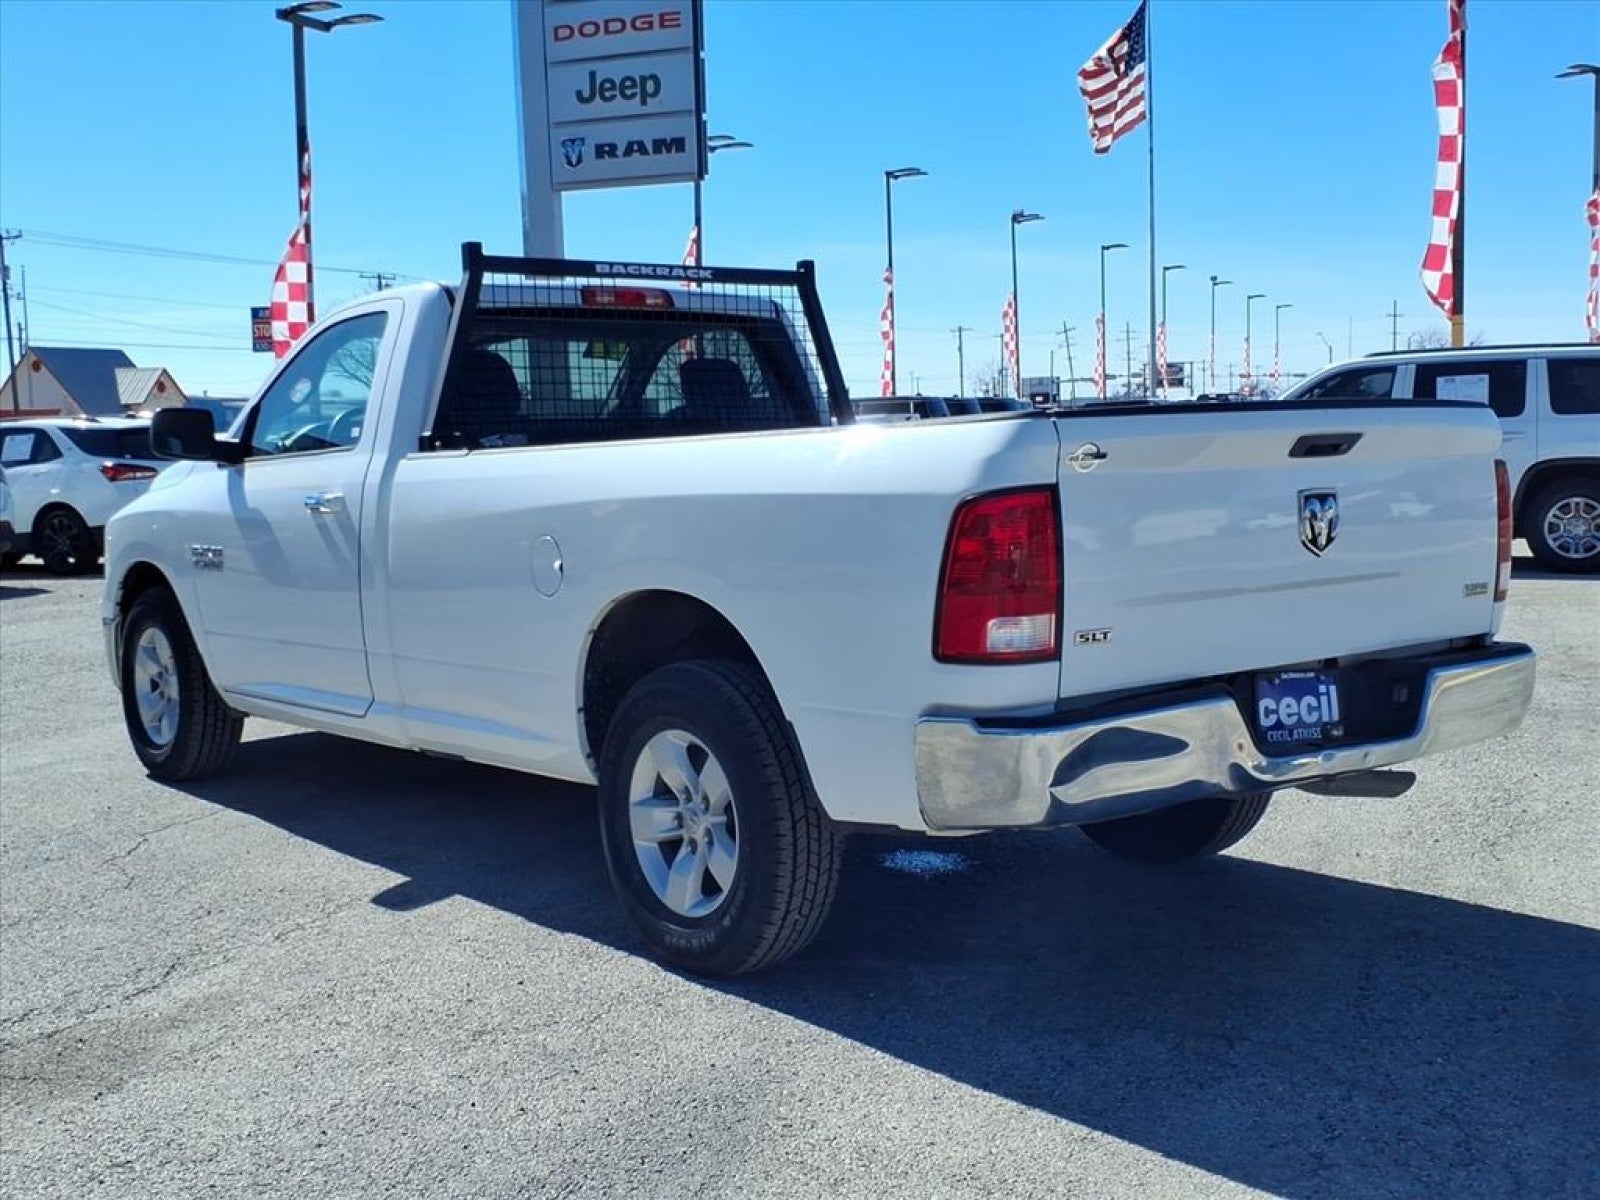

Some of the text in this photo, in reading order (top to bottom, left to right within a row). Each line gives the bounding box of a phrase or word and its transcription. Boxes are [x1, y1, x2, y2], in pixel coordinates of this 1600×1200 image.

[553, 11, 682, 42] DODGE
[575, 70, 662, 106] Jeep
[594, 137, 686, 160] RAM
[595, 264, 713, 279] BACKRACK
[1076, 629, 1112, 643] SLT
[1258, 685, 1340, 727] cecil
